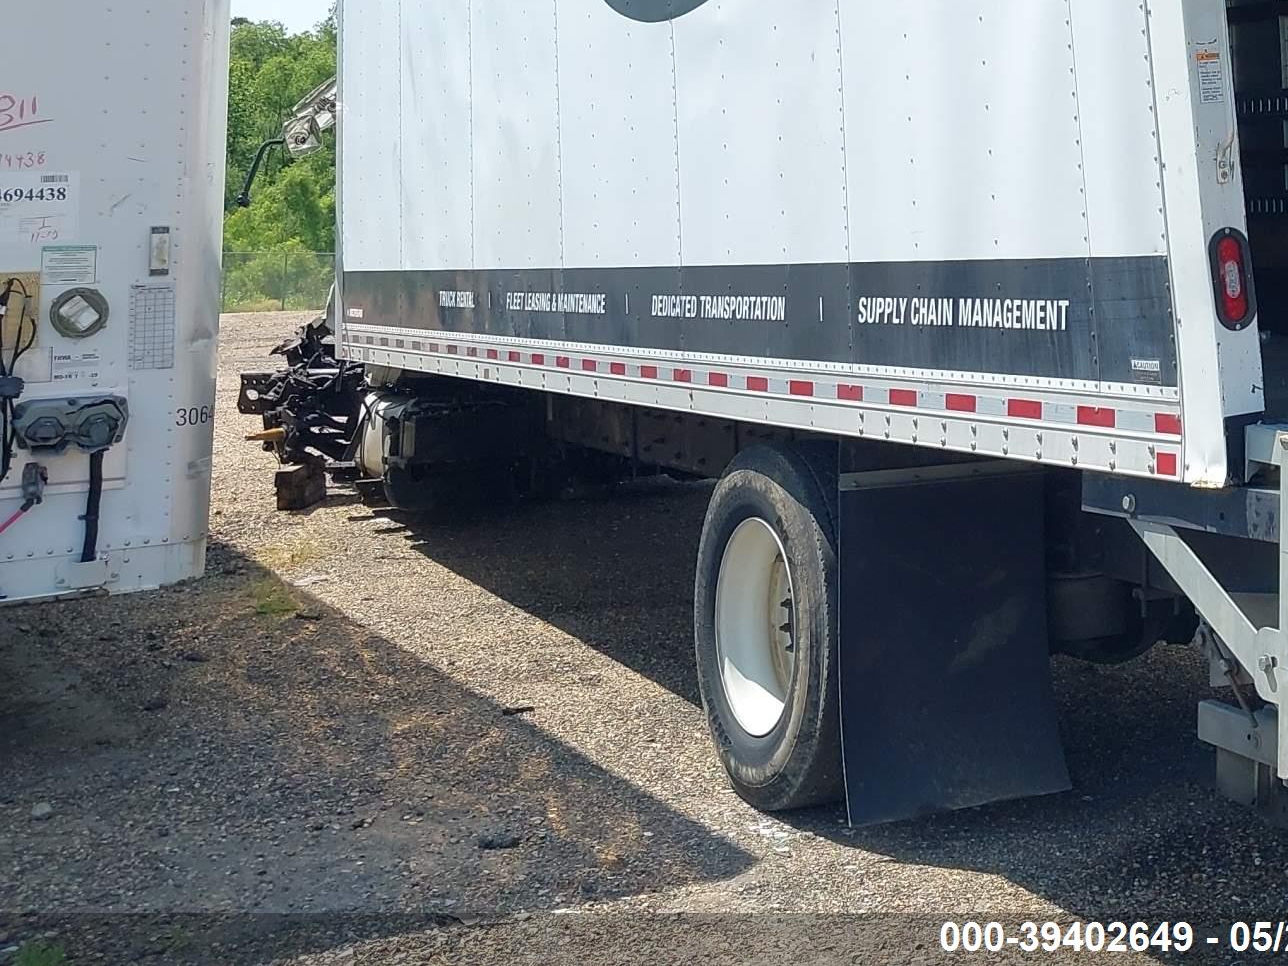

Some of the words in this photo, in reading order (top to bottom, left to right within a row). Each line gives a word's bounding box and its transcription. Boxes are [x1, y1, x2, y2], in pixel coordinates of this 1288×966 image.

[439, 291, 456, 307] TRUCK
[506, 292, 524, 310] FLEET
[524, 292, 550, 311] LEASING
[551, 294, 557, 311] &
[558, 293, 606, 314] MAINTENANCE
[651, 295, 697, 318] DEDICATED
[700, 296, 786, 321] TRANSPORTATION
[857, 297, 908, 326] SUPPLY
[910, 297, 953, 327] CHAIN
[958, 299, 1070, 331] MANAGEMENT
[1136, 361, 1159, 370] CAUTION
